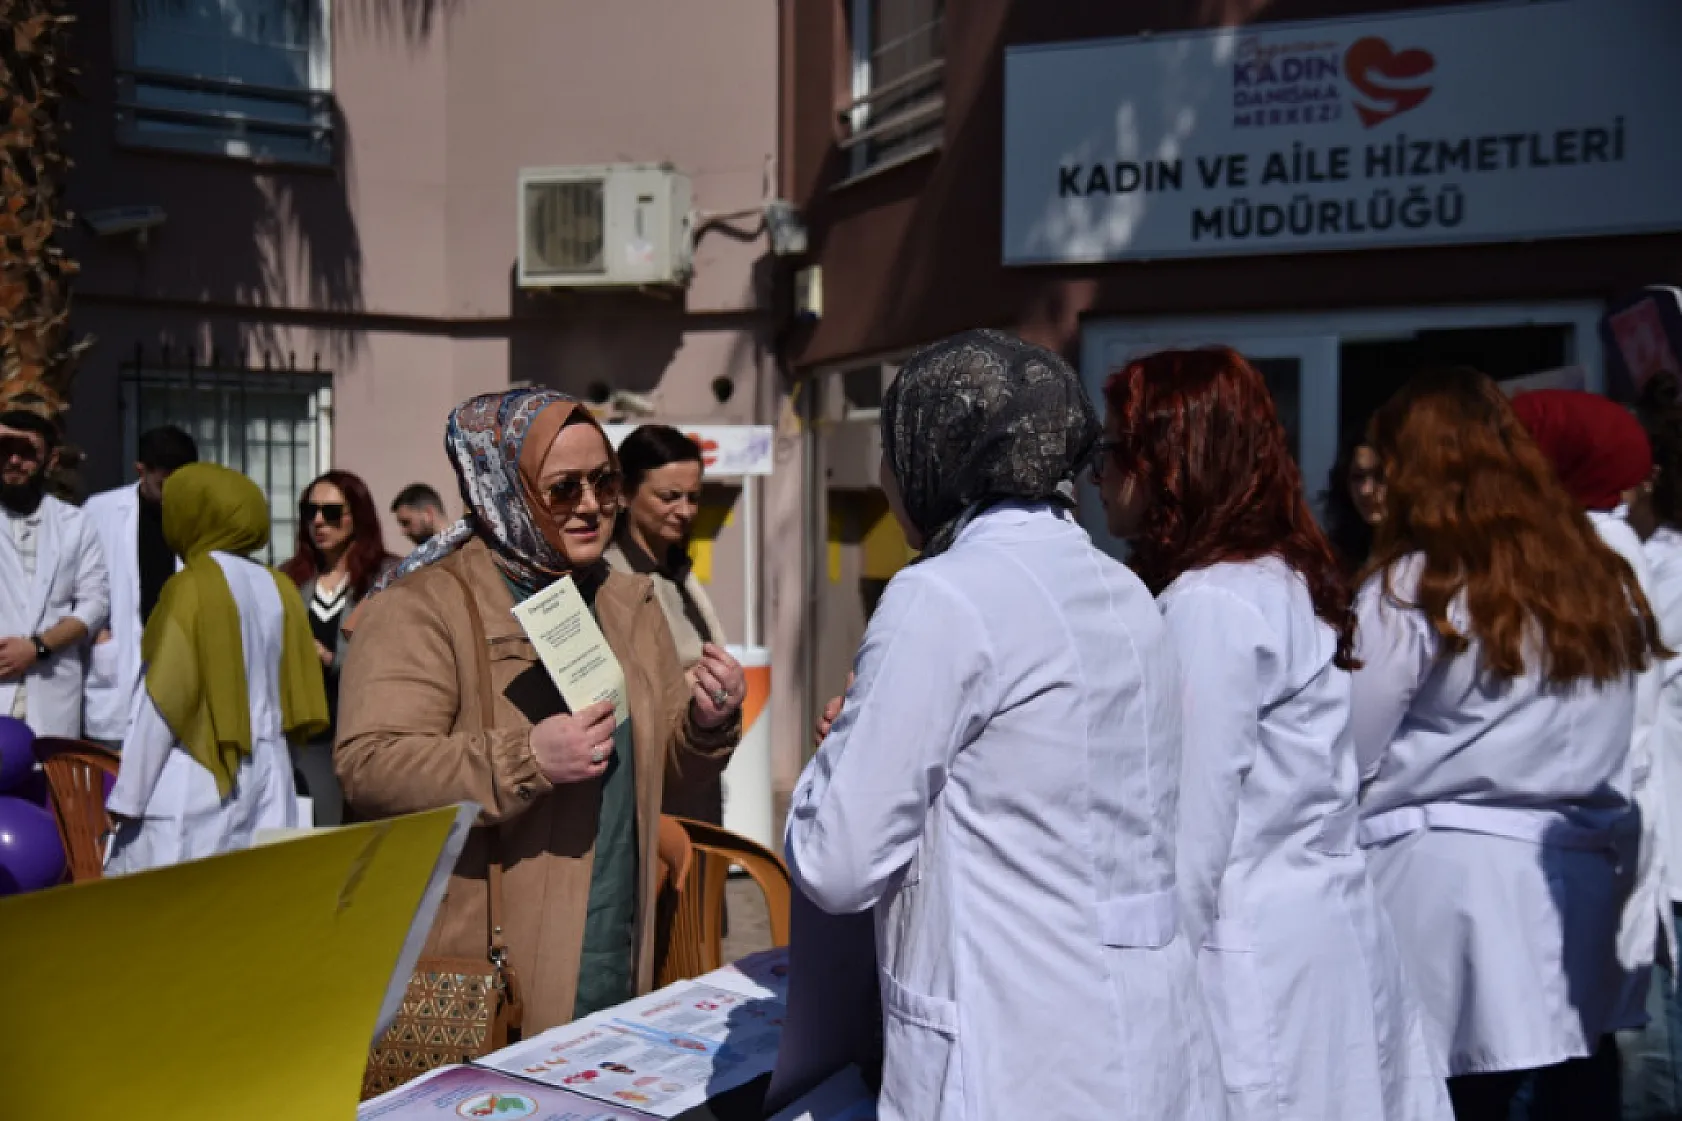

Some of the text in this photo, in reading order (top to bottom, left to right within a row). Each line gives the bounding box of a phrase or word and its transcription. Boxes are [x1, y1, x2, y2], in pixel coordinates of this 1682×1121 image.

[1234, 54, 1339, 87] KADIN
[1059, 115, 1624, 197] KADIN VE AİLE HİZMETLERİ
[1192, 184, 1464, 241] MÜDÜRLÜĞÜ
